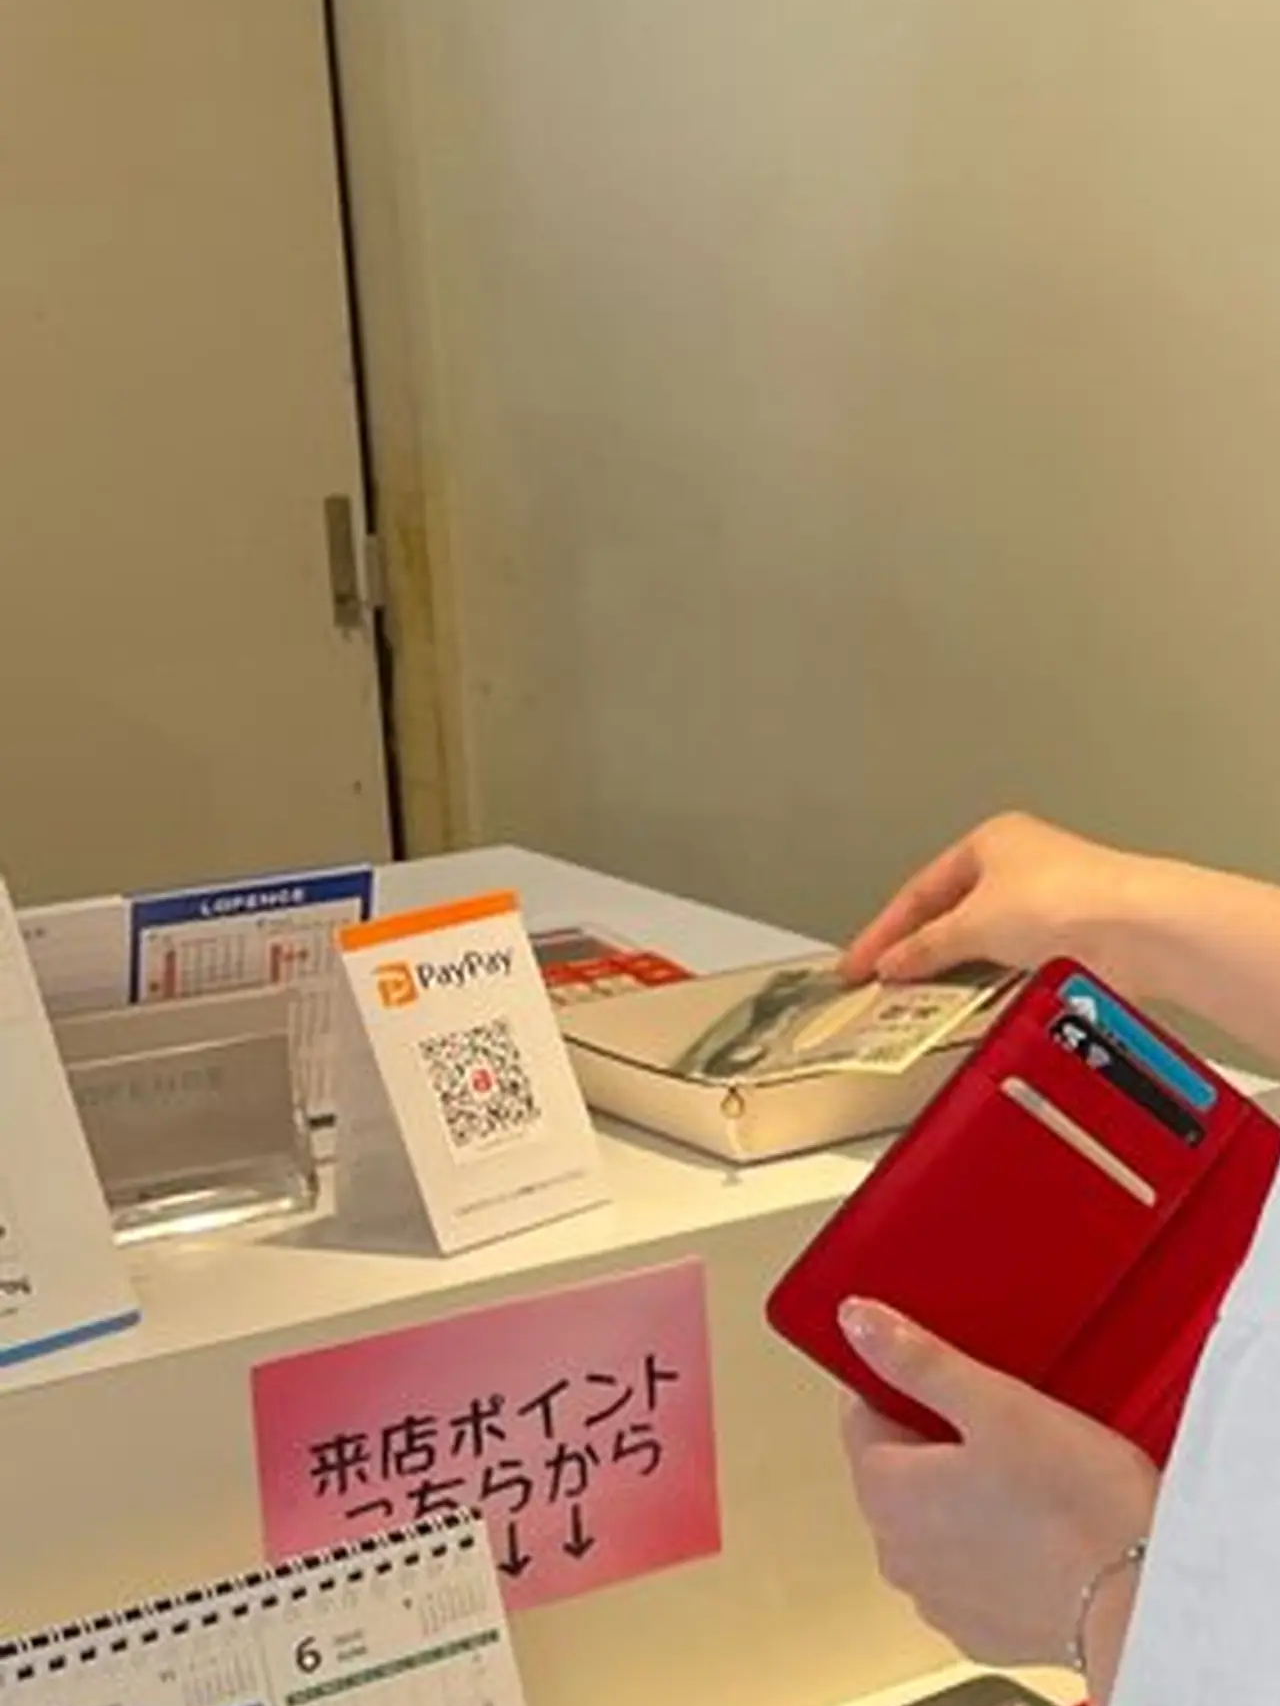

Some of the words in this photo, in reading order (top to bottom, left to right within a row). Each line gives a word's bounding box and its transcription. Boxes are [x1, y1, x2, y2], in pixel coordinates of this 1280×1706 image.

[416, 947, 512, 989] PayPay
[310, 1354, 679, 1499] 来店ポイント
[295, 1637, 322, 1674] 6
